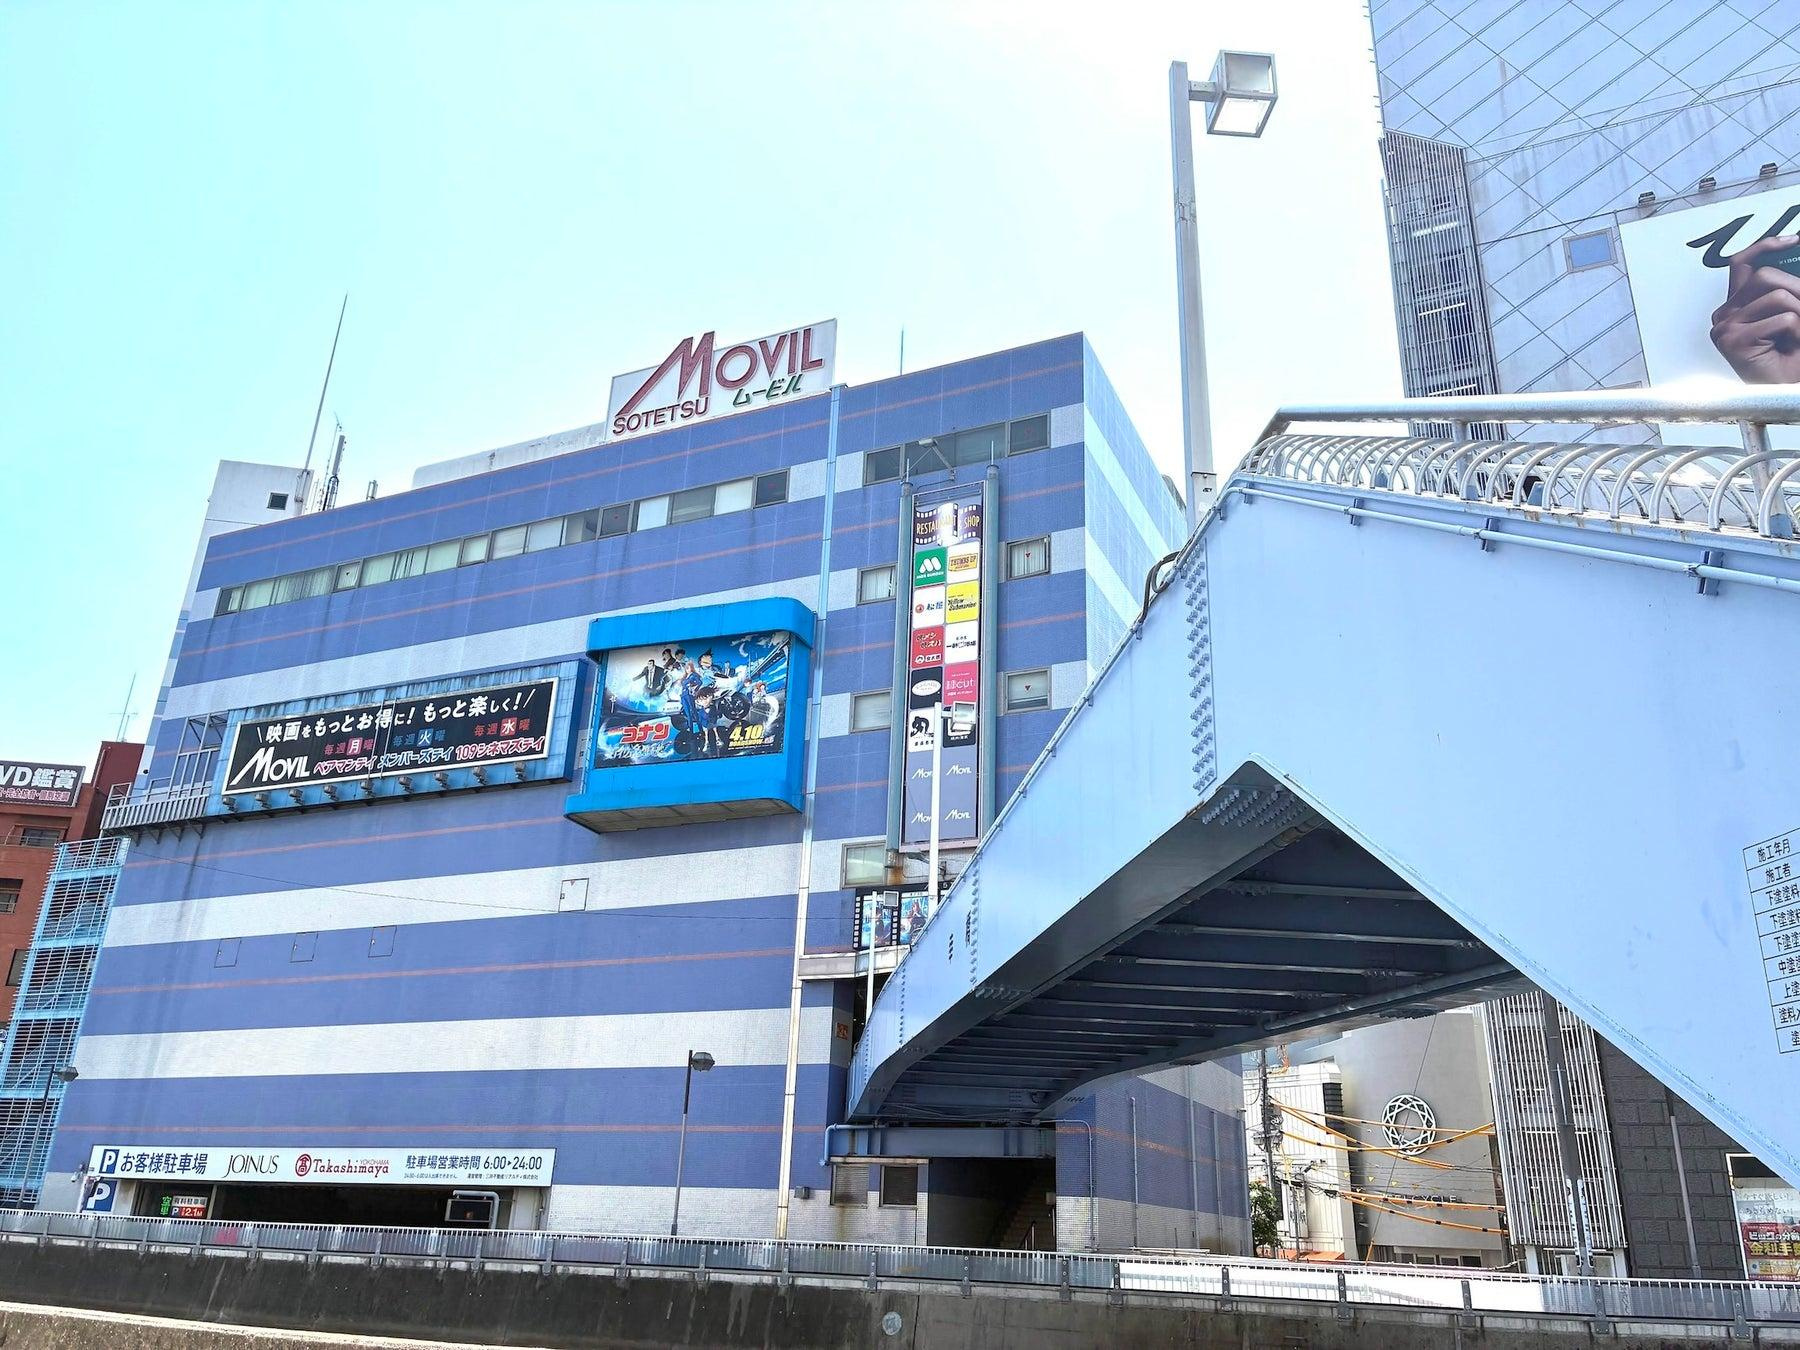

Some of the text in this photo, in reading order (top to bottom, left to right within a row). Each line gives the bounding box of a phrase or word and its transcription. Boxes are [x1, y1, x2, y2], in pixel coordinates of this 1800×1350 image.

[615, 327, 824, 417] MOVIL
[732, 373, 804, 408] ムービル
[612, 397, 709, 435] SOTETSU
[964, 515, 980, 530] SHOP
[473, 718, 531, 737] 毎週水曜
[620, 722, 670, 745] コナン
[729, 724, 764, 741] 4.10
[323, 737, 375, 757] 毎週月曜
[229, 746, 310, 786] MOVIL
[912, 768, 932, 779] MOV
[911, 812, 931, 823] MOV
[1757, 838, 1791, 863] 施工年月
[1765, 862, 1791, 884] 施工者
[120, 1152, 209, 1175] お客様駐車場
[221, 1154, 280, 1179] JOINUS
[313, 1158, 390, 1179] Takashimaya
[405, 1154, 481, 1171] 駐車場営業時間
